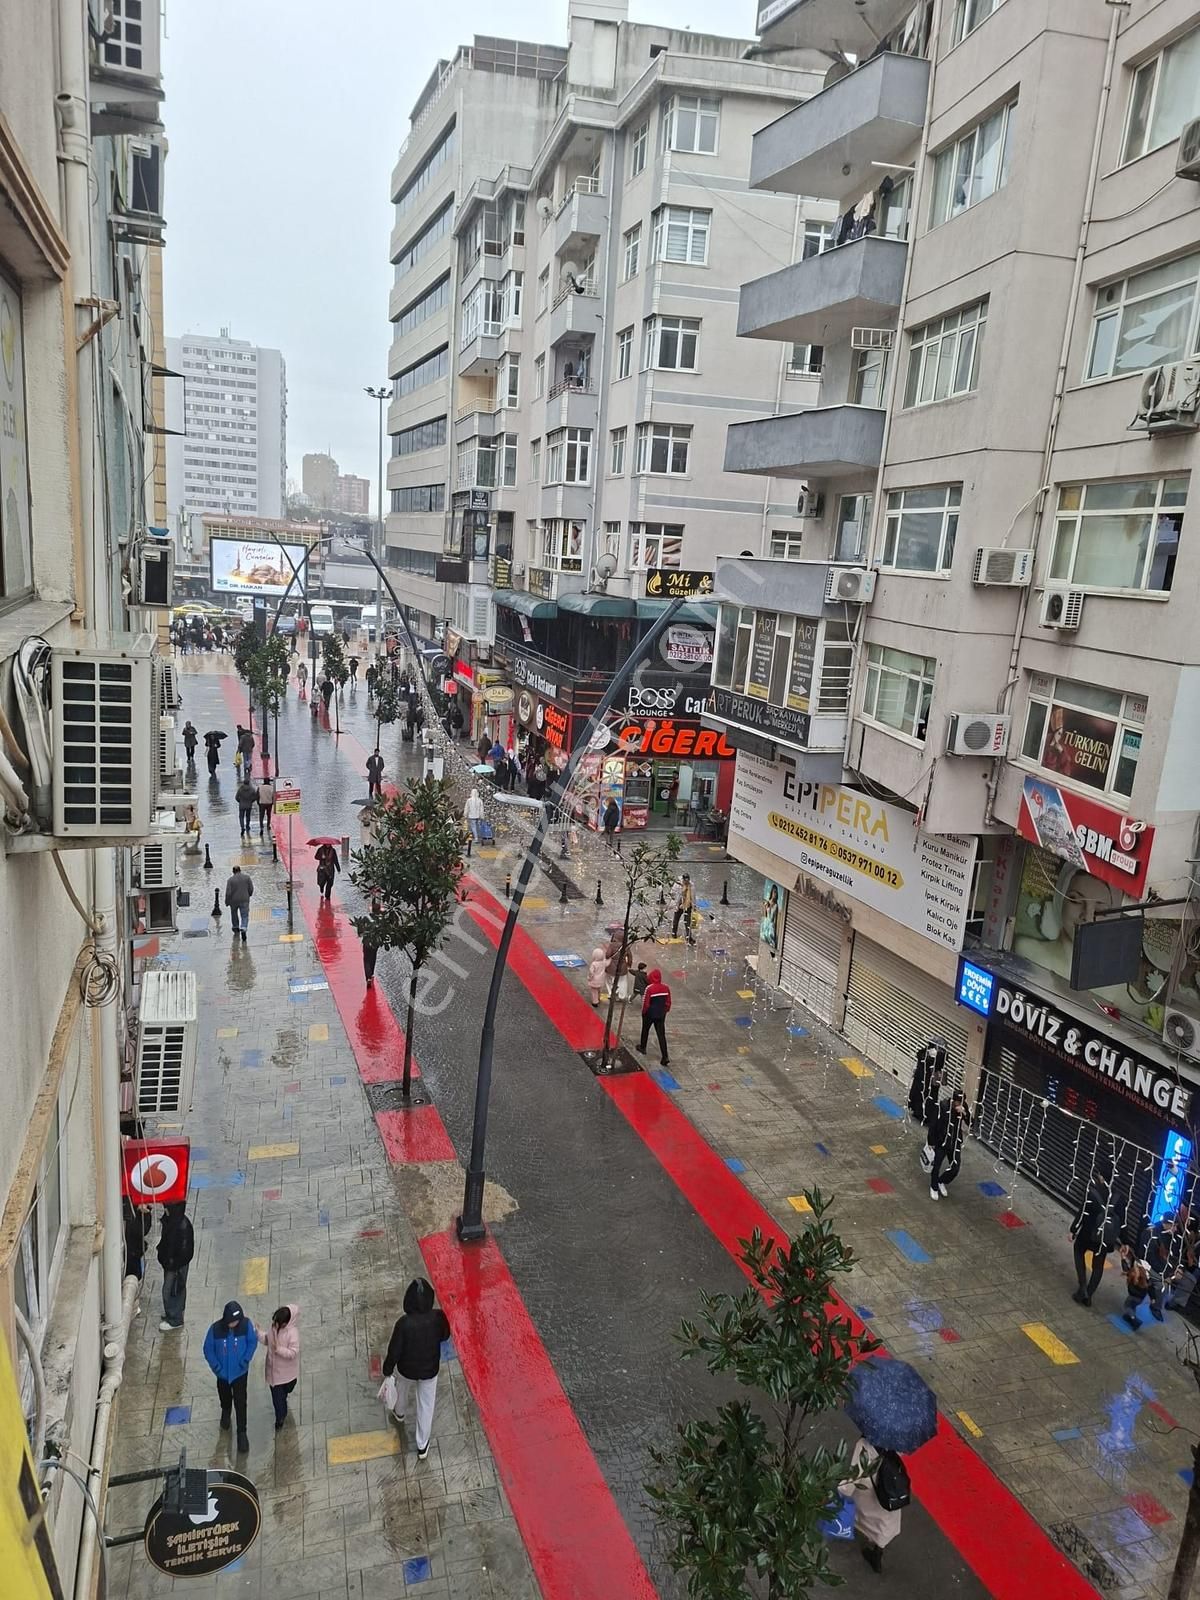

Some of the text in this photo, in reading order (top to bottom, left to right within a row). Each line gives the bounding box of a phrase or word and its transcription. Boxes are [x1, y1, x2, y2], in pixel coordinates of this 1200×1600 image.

[666, 573, 713, 588] Mi &
[758, 615, 776, 633] ART
[797, 623, 818, 643] ART
[671, 644, 711, 654] SATILIK
[628, 687, 676, 709] BOSS
[707, 689, 731, 713] ART
[732, 697, 763, 725] PERUK
[636, 709, 668, 717] LOUNGE
[1064, 730, 1114, 759] TÜRKMEN
[778, 818, 828, 851] 0212 452 81 76
[841, 829, 885, 854] SALONU
[1075, 824, 1113, 862] SBM
[922, 839, 968, 866] Kuru Manikür
[1111, 851, 1135, 874] group
[837, 847, 898, 886] 0537 971 00 12
[921, 854, 966, 881] Protez Tırnak
[920, 869, 964, 898] Kirpik Lifting
[939, 896, 961, 915] Kirpik
[926, 922, 956, 946] Blok Kaş
[946, 918, 959, 931] Oje
[996, 988, 1192, 1119] DÖVİZ & CHANGE
[164, 1543, 242, 1568] TEKNİK SERVİS
